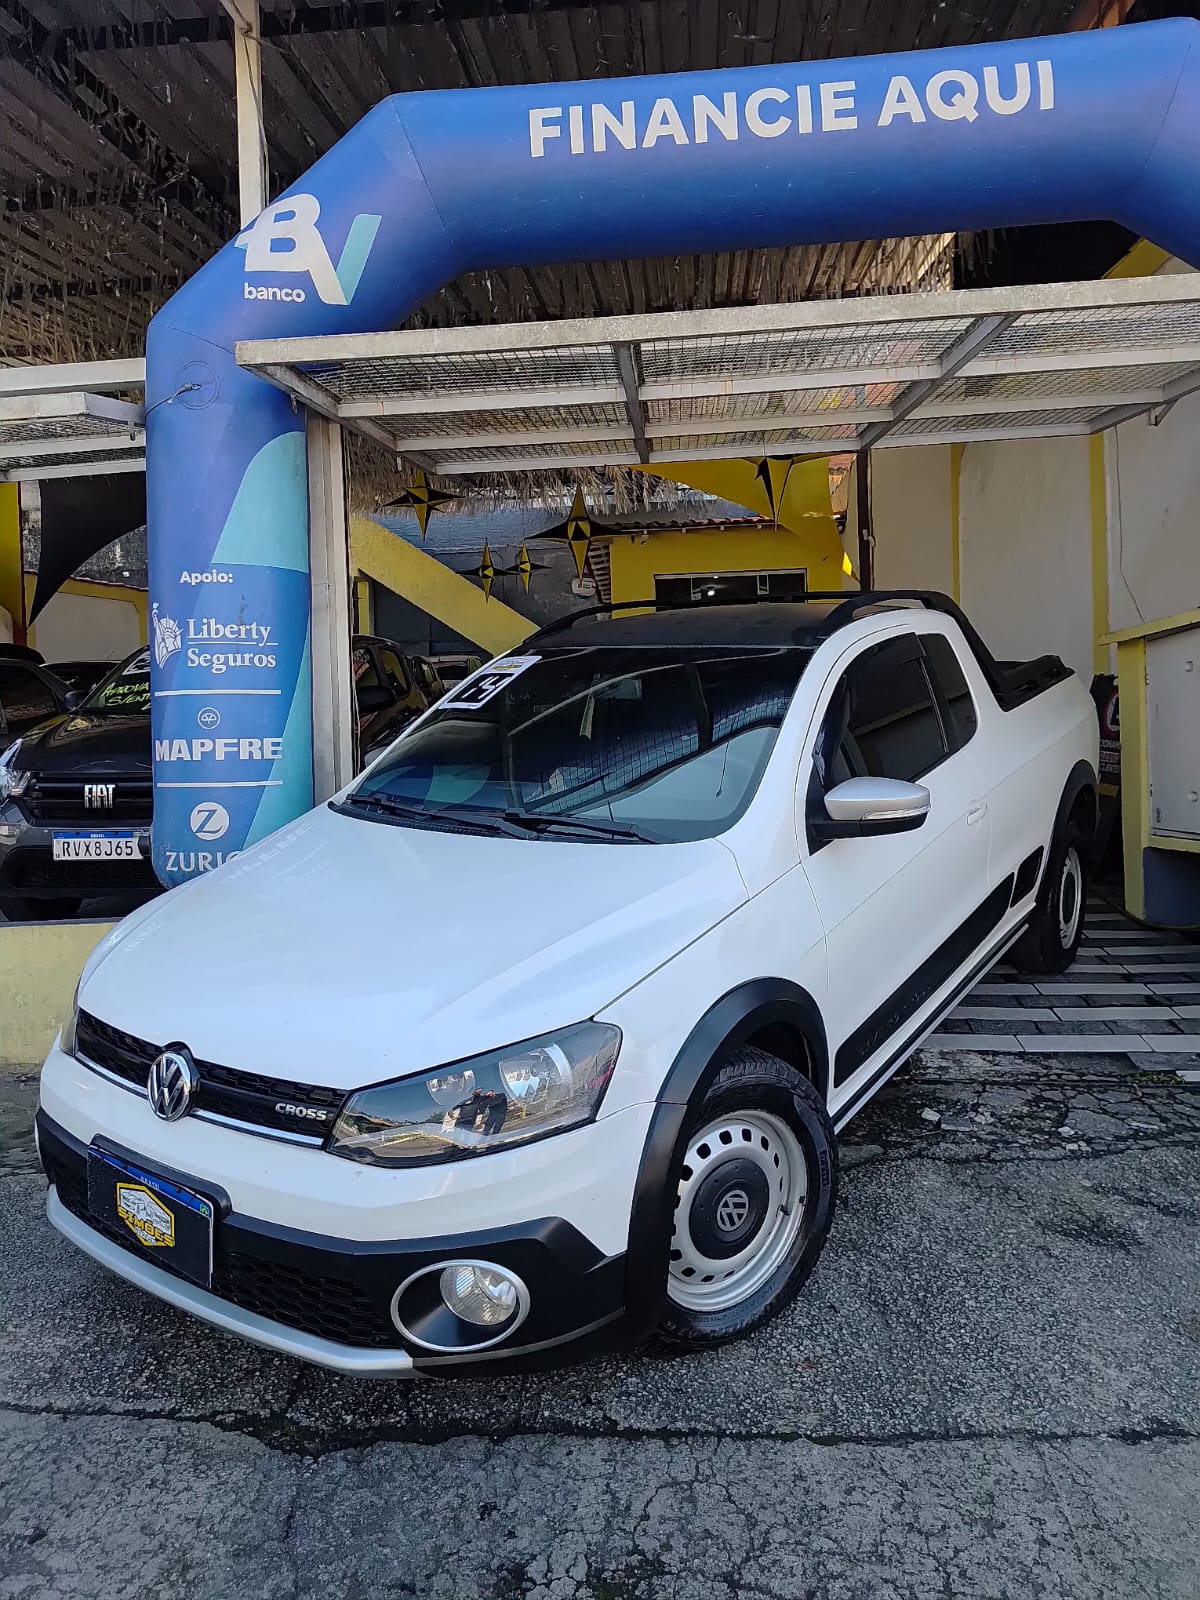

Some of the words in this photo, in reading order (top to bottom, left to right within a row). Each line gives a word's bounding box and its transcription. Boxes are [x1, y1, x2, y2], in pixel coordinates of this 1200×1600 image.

[529, 80, 858, 158] FINANCIE
[877, 60, 1054, 123] AQUI
[244, 282, 306, 302] banco
[180, 569, 234, 586] Apoio:
[187, 618, 272, 647] Liberty
[187, 648, 277, 674] Seguros
[155, 737, 283, 762] MAPFRE
[84, 784, 116, 808] FIAT
[62, 841, 134, 857] RVX8J65
[275, 1103, 328, 1121] CROSS
